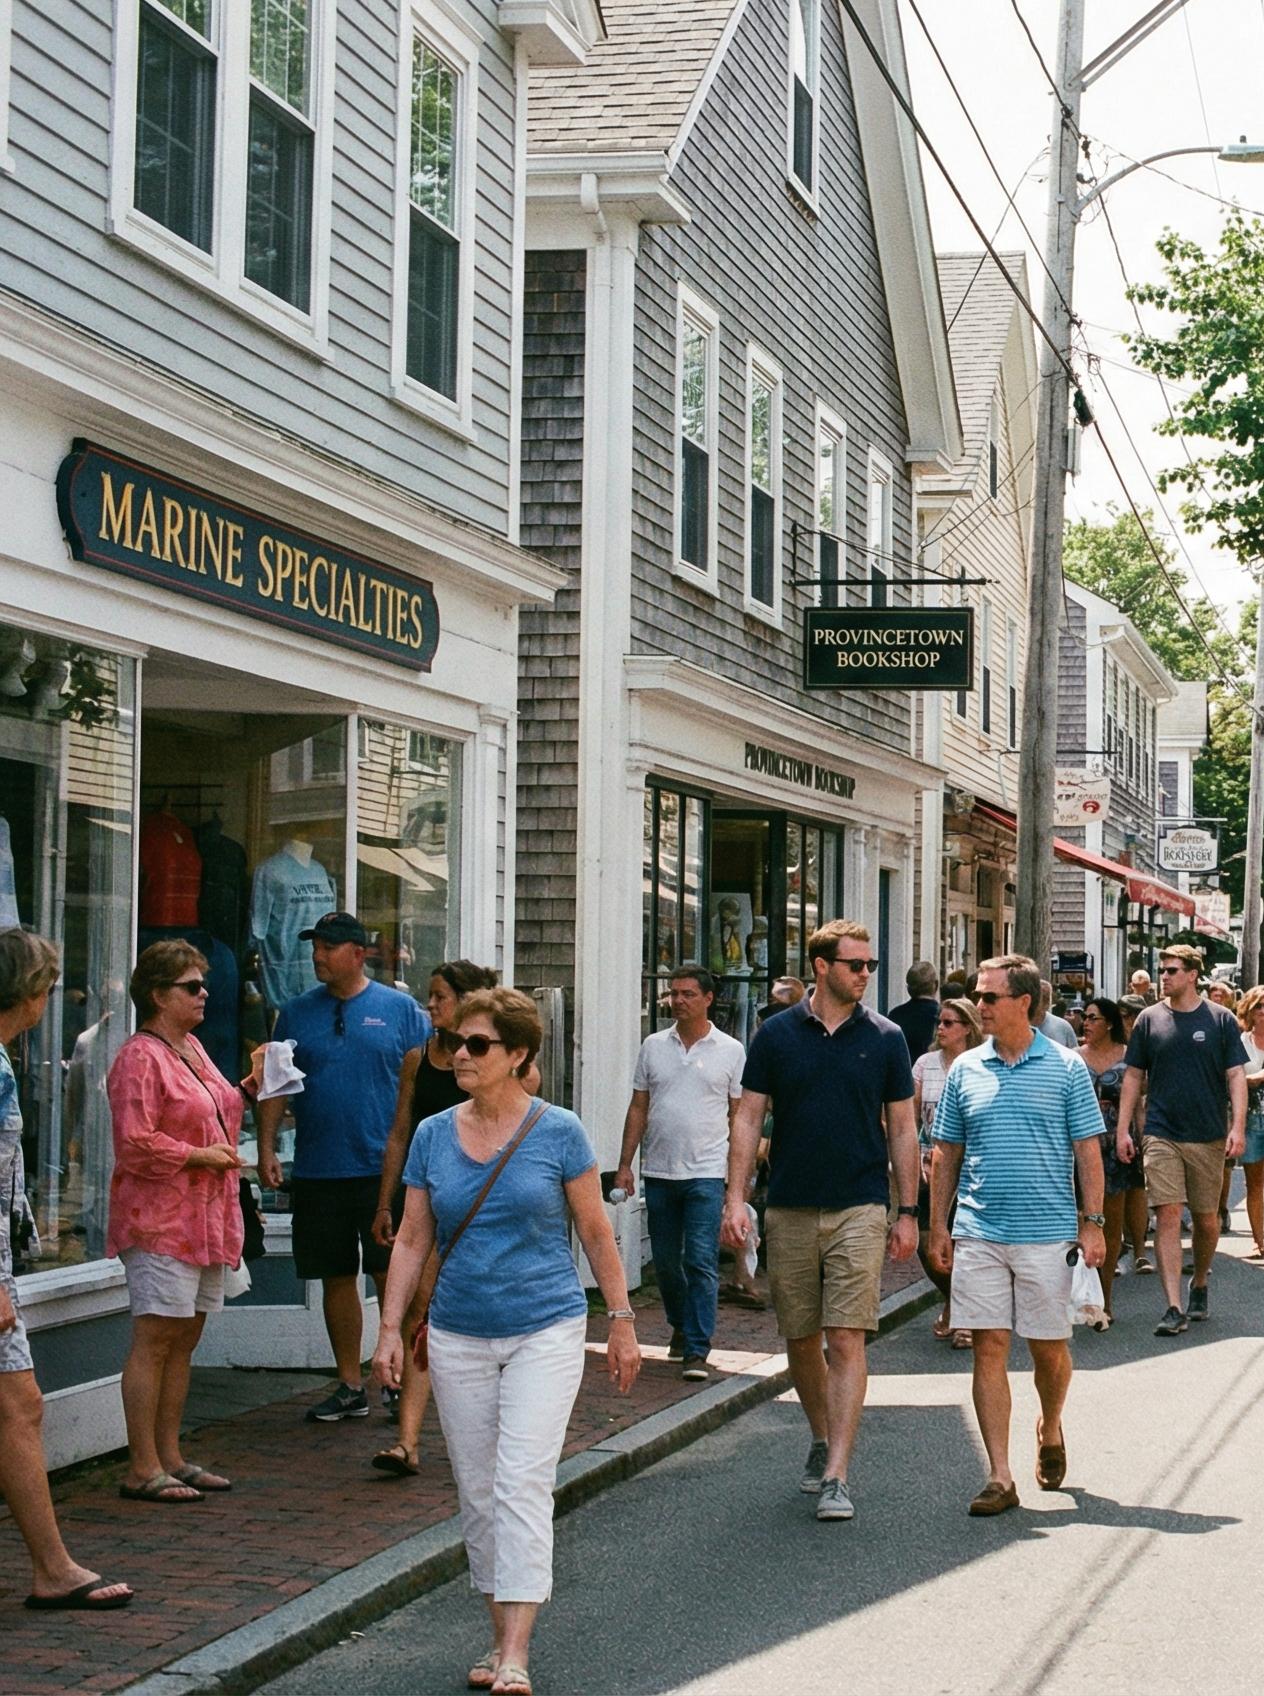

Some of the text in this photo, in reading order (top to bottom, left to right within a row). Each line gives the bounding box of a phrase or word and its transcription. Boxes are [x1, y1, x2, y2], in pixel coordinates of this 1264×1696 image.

[98, 471, 424, 649] MARINE SPECIALTIES
[813, 629, 964, 646] PROVINCETOWN
[837, 651, 940, 667] BOOKSHOP
